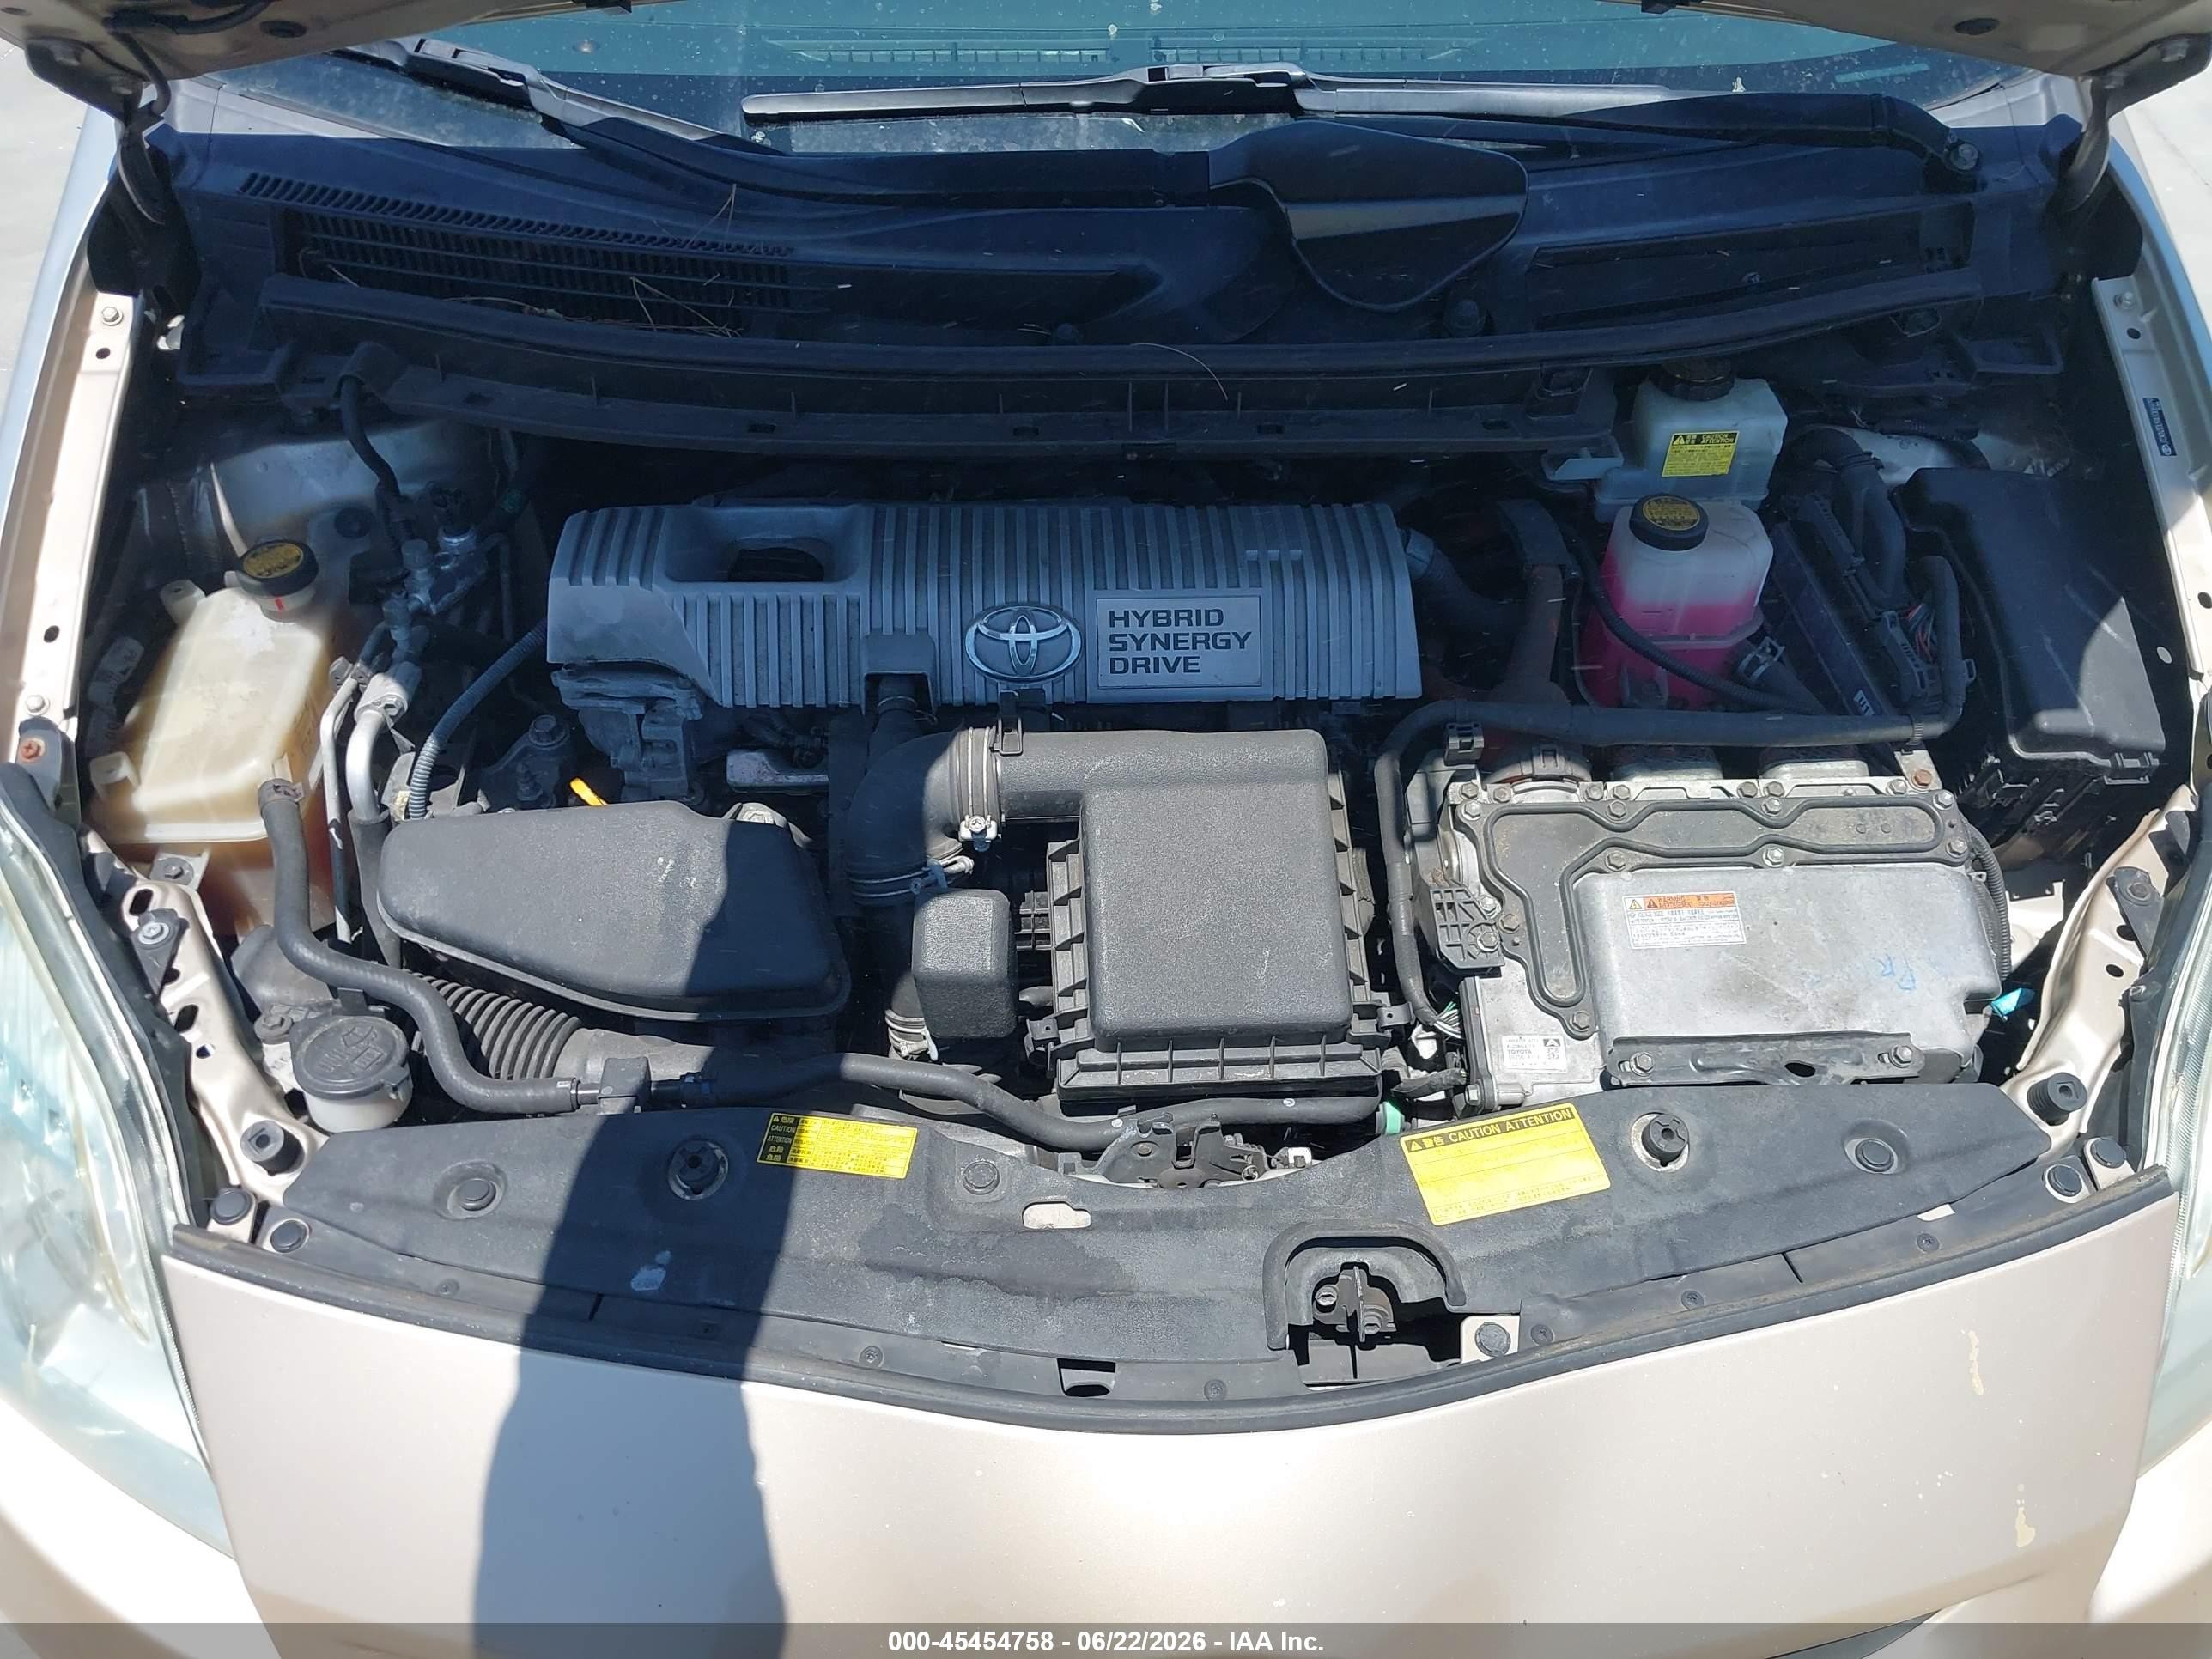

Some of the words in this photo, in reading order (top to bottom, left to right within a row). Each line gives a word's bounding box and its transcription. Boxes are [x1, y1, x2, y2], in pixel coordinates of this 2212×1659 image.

[1109, 609, 1224, 628] HYBRID
[1109, 631, 1252, 652] SYNERGY
[1109, 656, 1201, 674] DRIVE
[1449, 1123, 1501, 1143] CAUTION
[1505, 1109, 1571, 1132] ATTENTION
